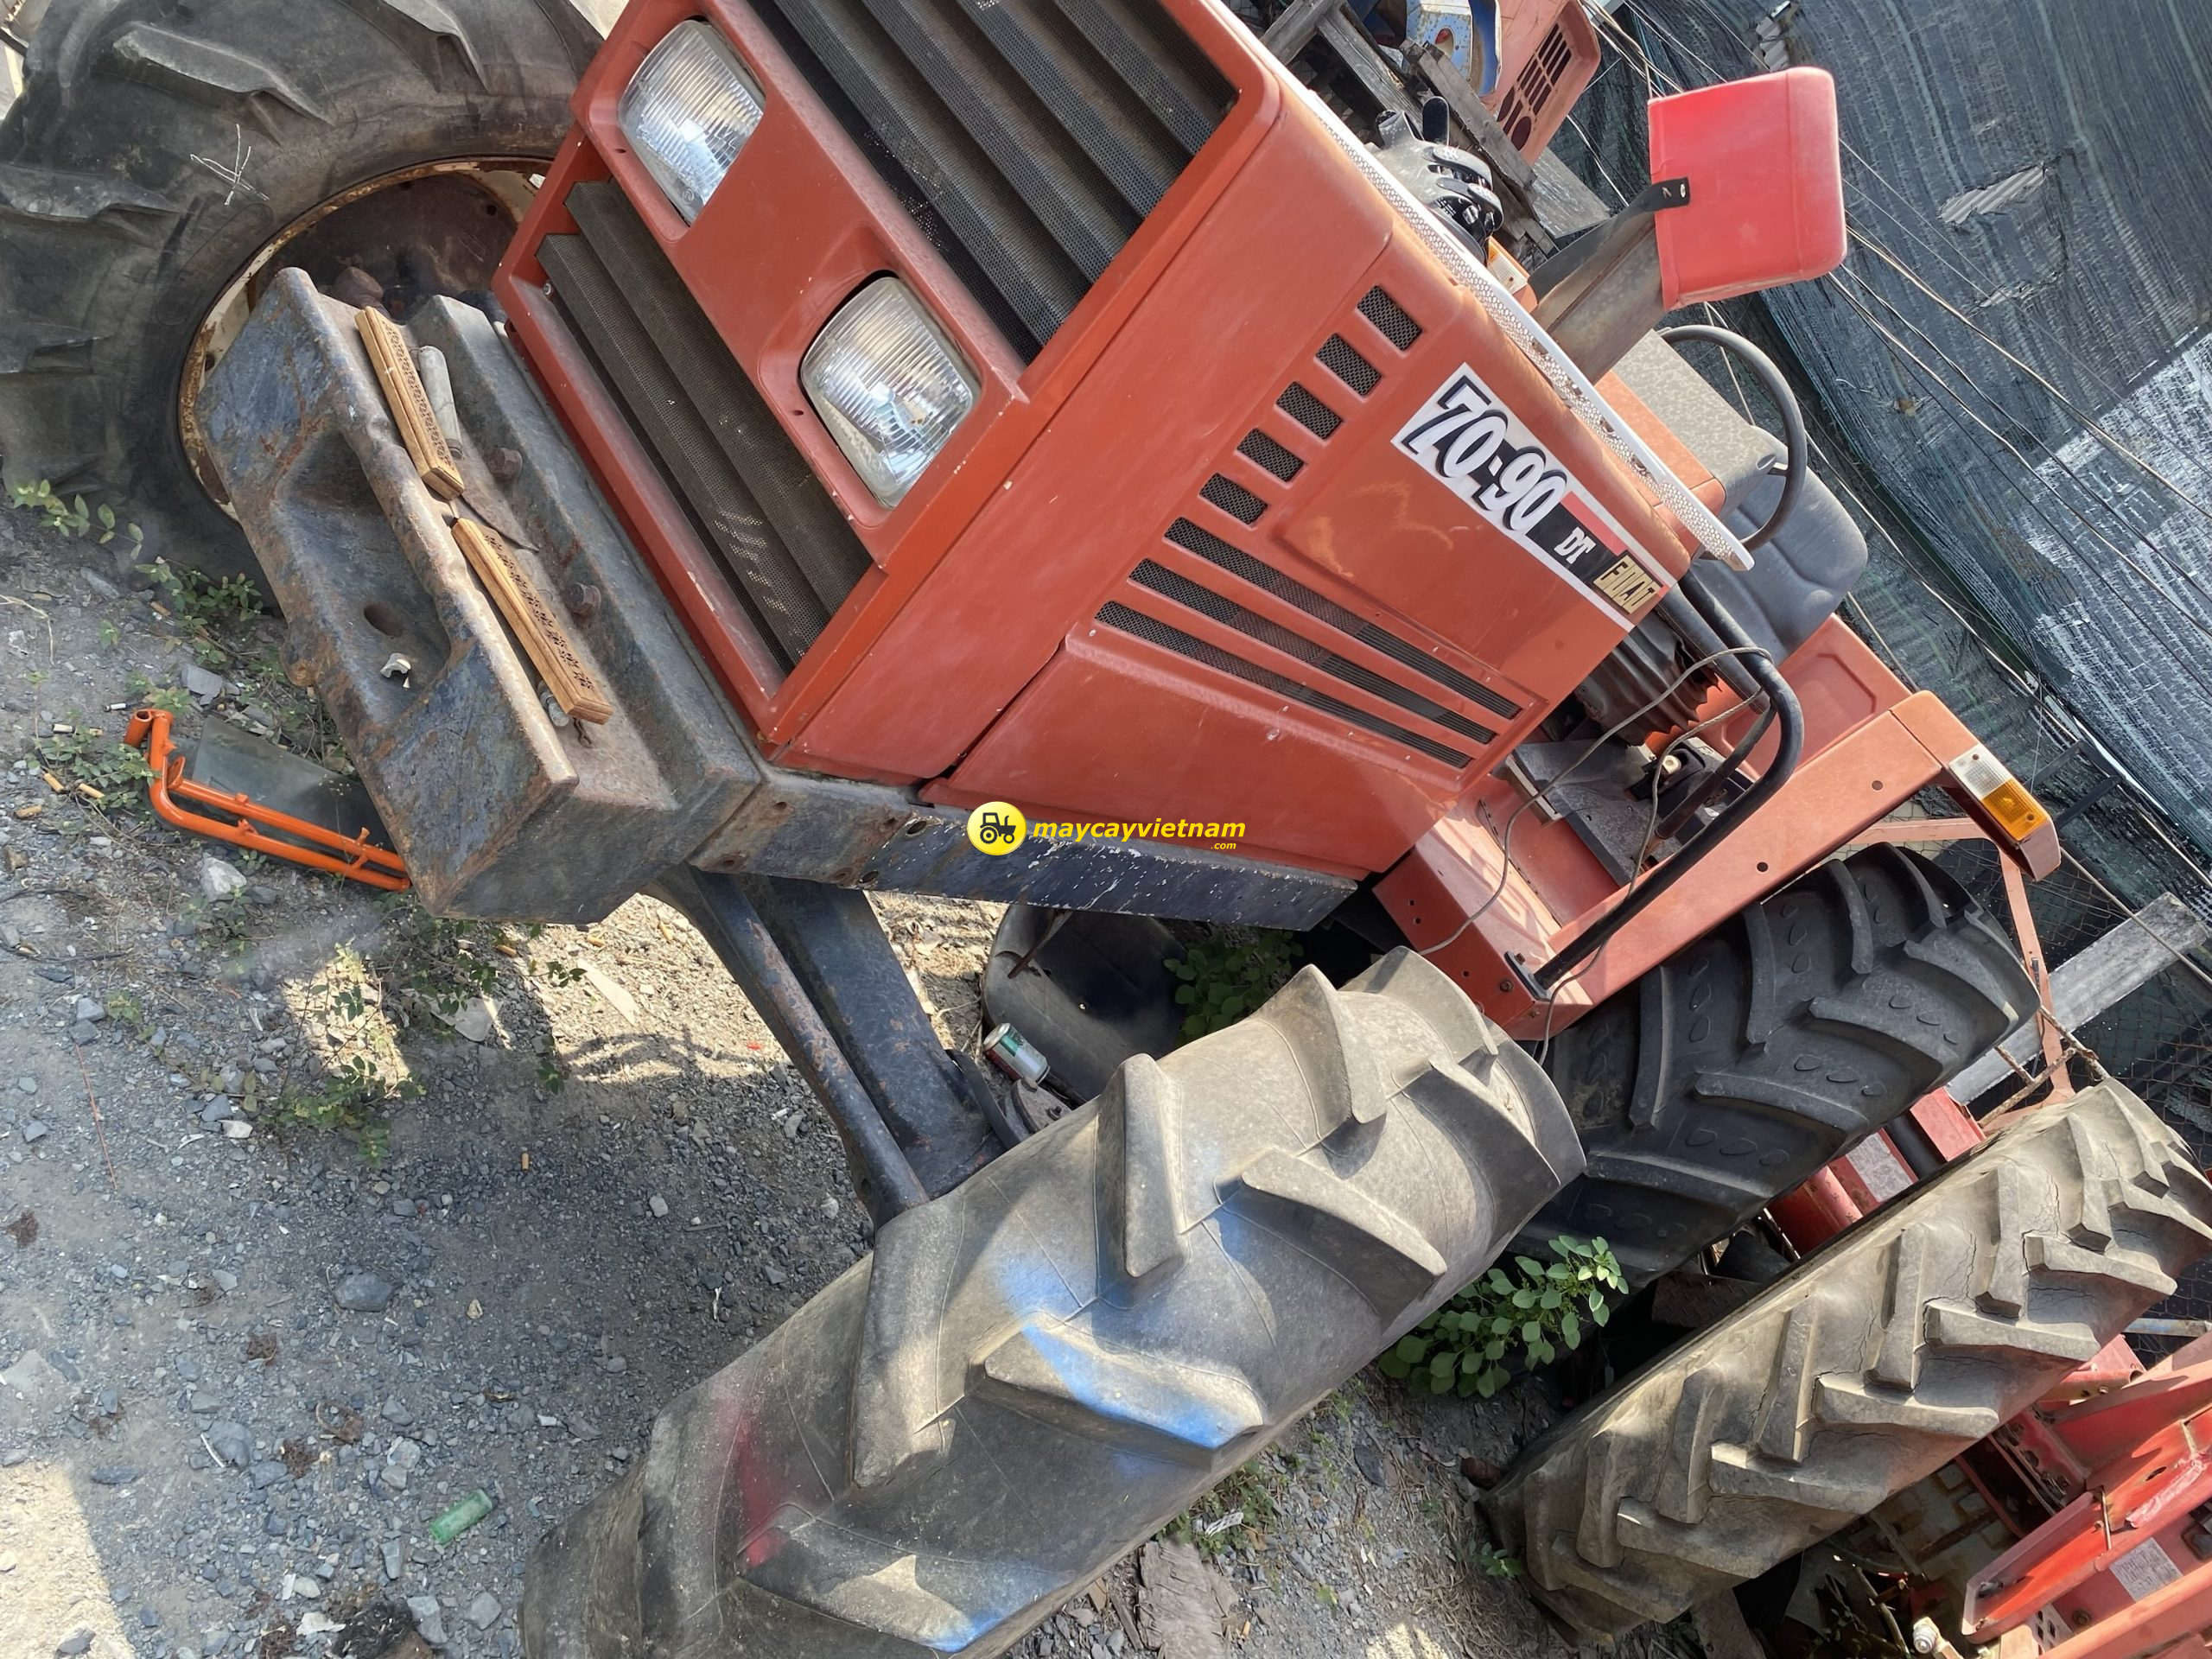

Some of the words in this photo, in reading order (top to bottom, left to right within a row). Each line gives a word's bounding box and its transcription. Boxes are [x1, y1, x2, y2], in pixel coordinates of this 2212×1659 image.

[1401, 374, 1567, 531] 70-90
[1554, 526, 1597, 565] DT
[1599, 560, 1656, 608] FIAT
